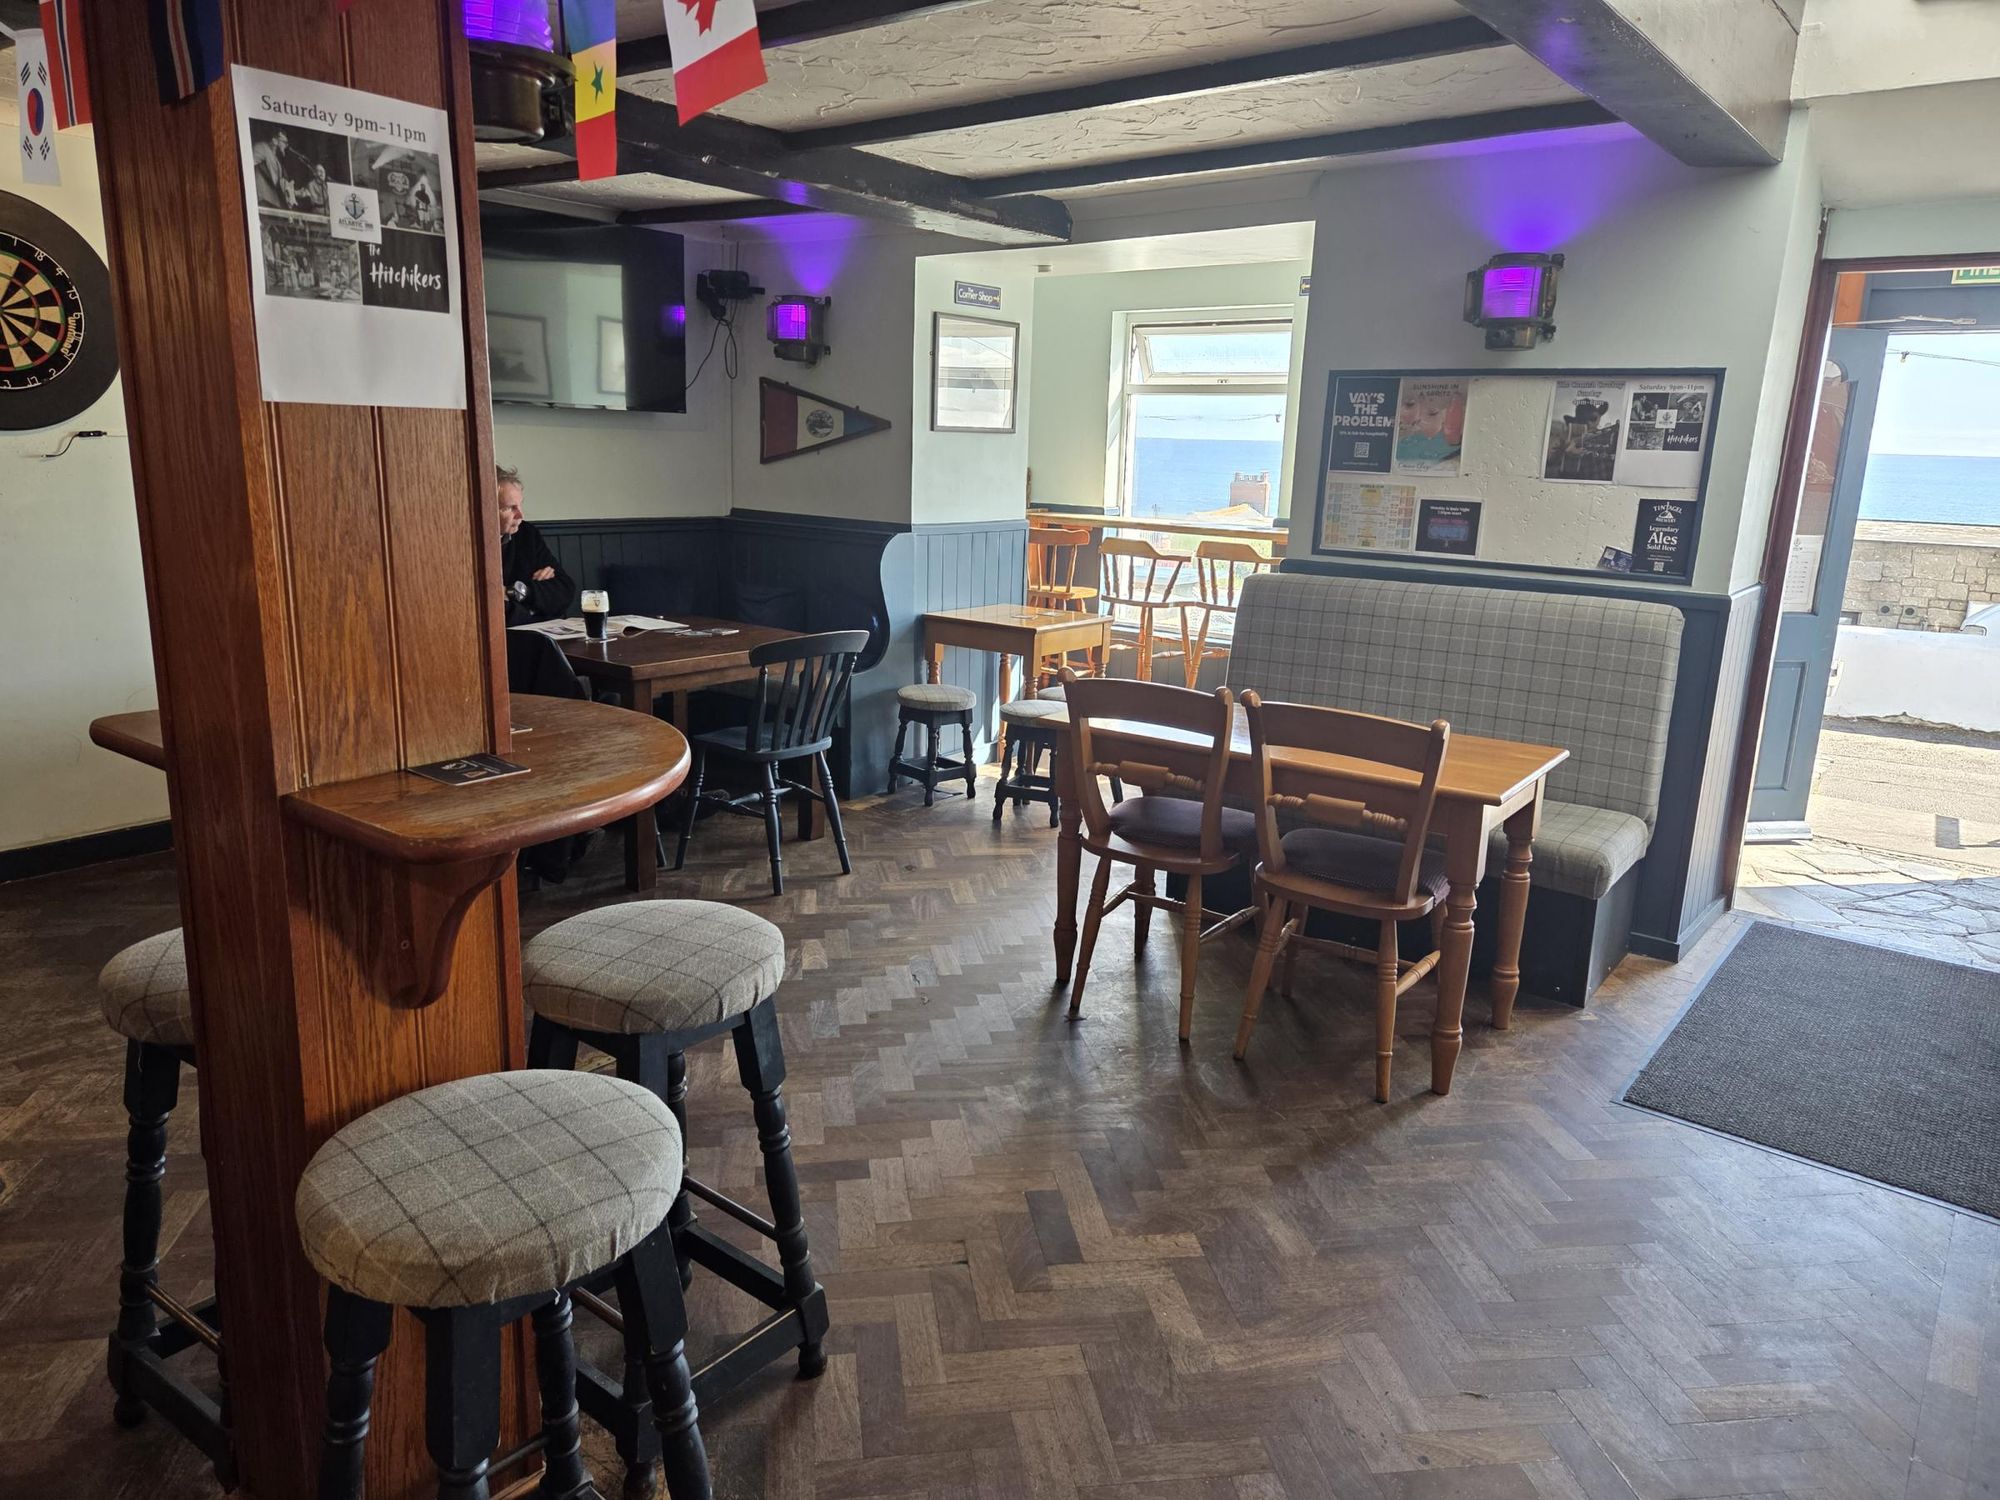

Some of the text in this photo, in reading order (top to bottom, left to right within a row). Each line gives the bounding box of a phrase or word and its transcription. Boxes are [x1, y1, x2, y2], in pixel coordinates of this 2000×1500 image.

[261, 95, 427, 143] Saturday 9pm-11pm
[369, 262, 442, 292] Hitchikers
[958, 288, 993, 304] Corner Shop
[1639, 383, 1705, 391] Saturday 9pm-11pm
[1353, 403, 1379, 415] THE
[1333, 415, 1394, 428] PROBLEM
[1653, 502, 1683, 514] TINTAGEL
[1649, 525, 1680, 534] Legendary
[1647, 531, 1679, 545] Ales
